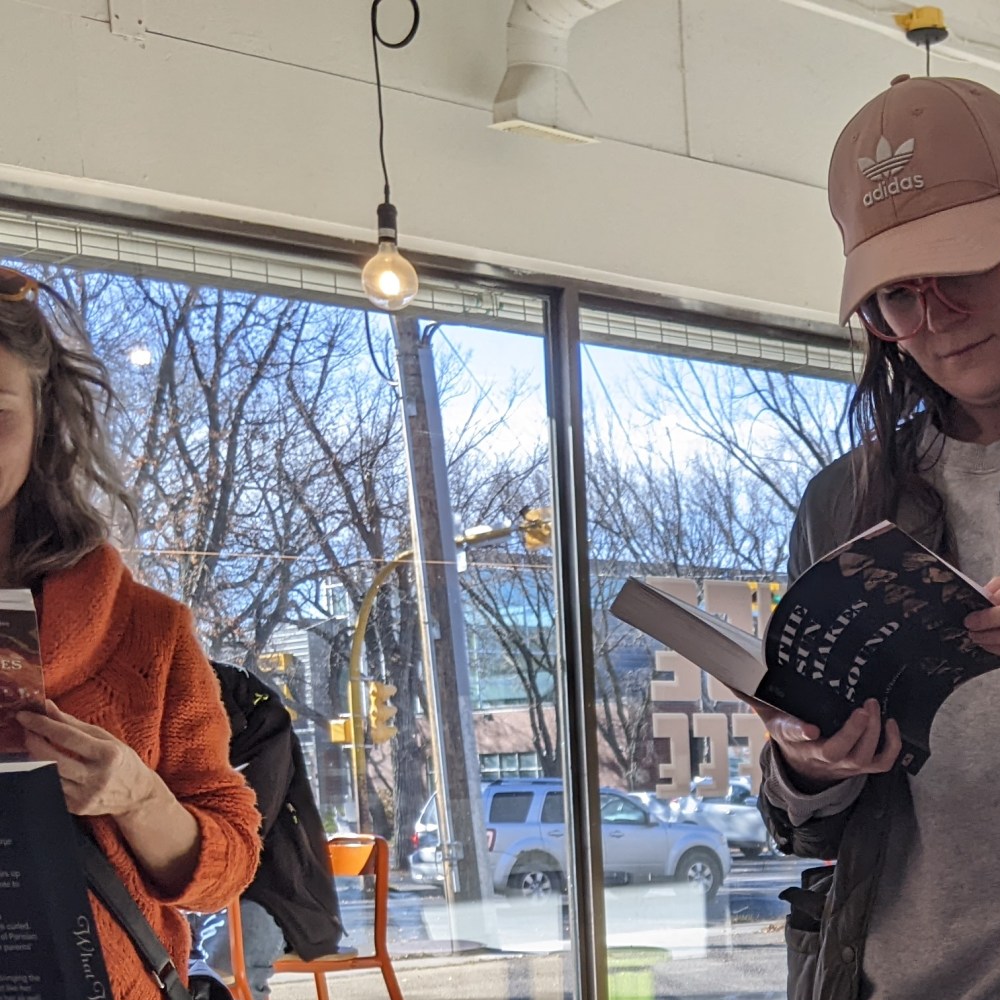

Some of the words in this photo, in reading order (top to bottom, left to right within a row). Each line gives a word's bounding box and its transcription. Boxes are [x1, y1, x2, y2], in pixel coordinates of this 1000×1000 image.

[862, 173, 925, 208] adidas
[778, 604, 808, 666] THE
[796, 619, 822, 677] SUN
[812, 599, 869, 684] MAKES
[846, 621, 900, 702] SOUND
[73, 914, 95, 980] What
